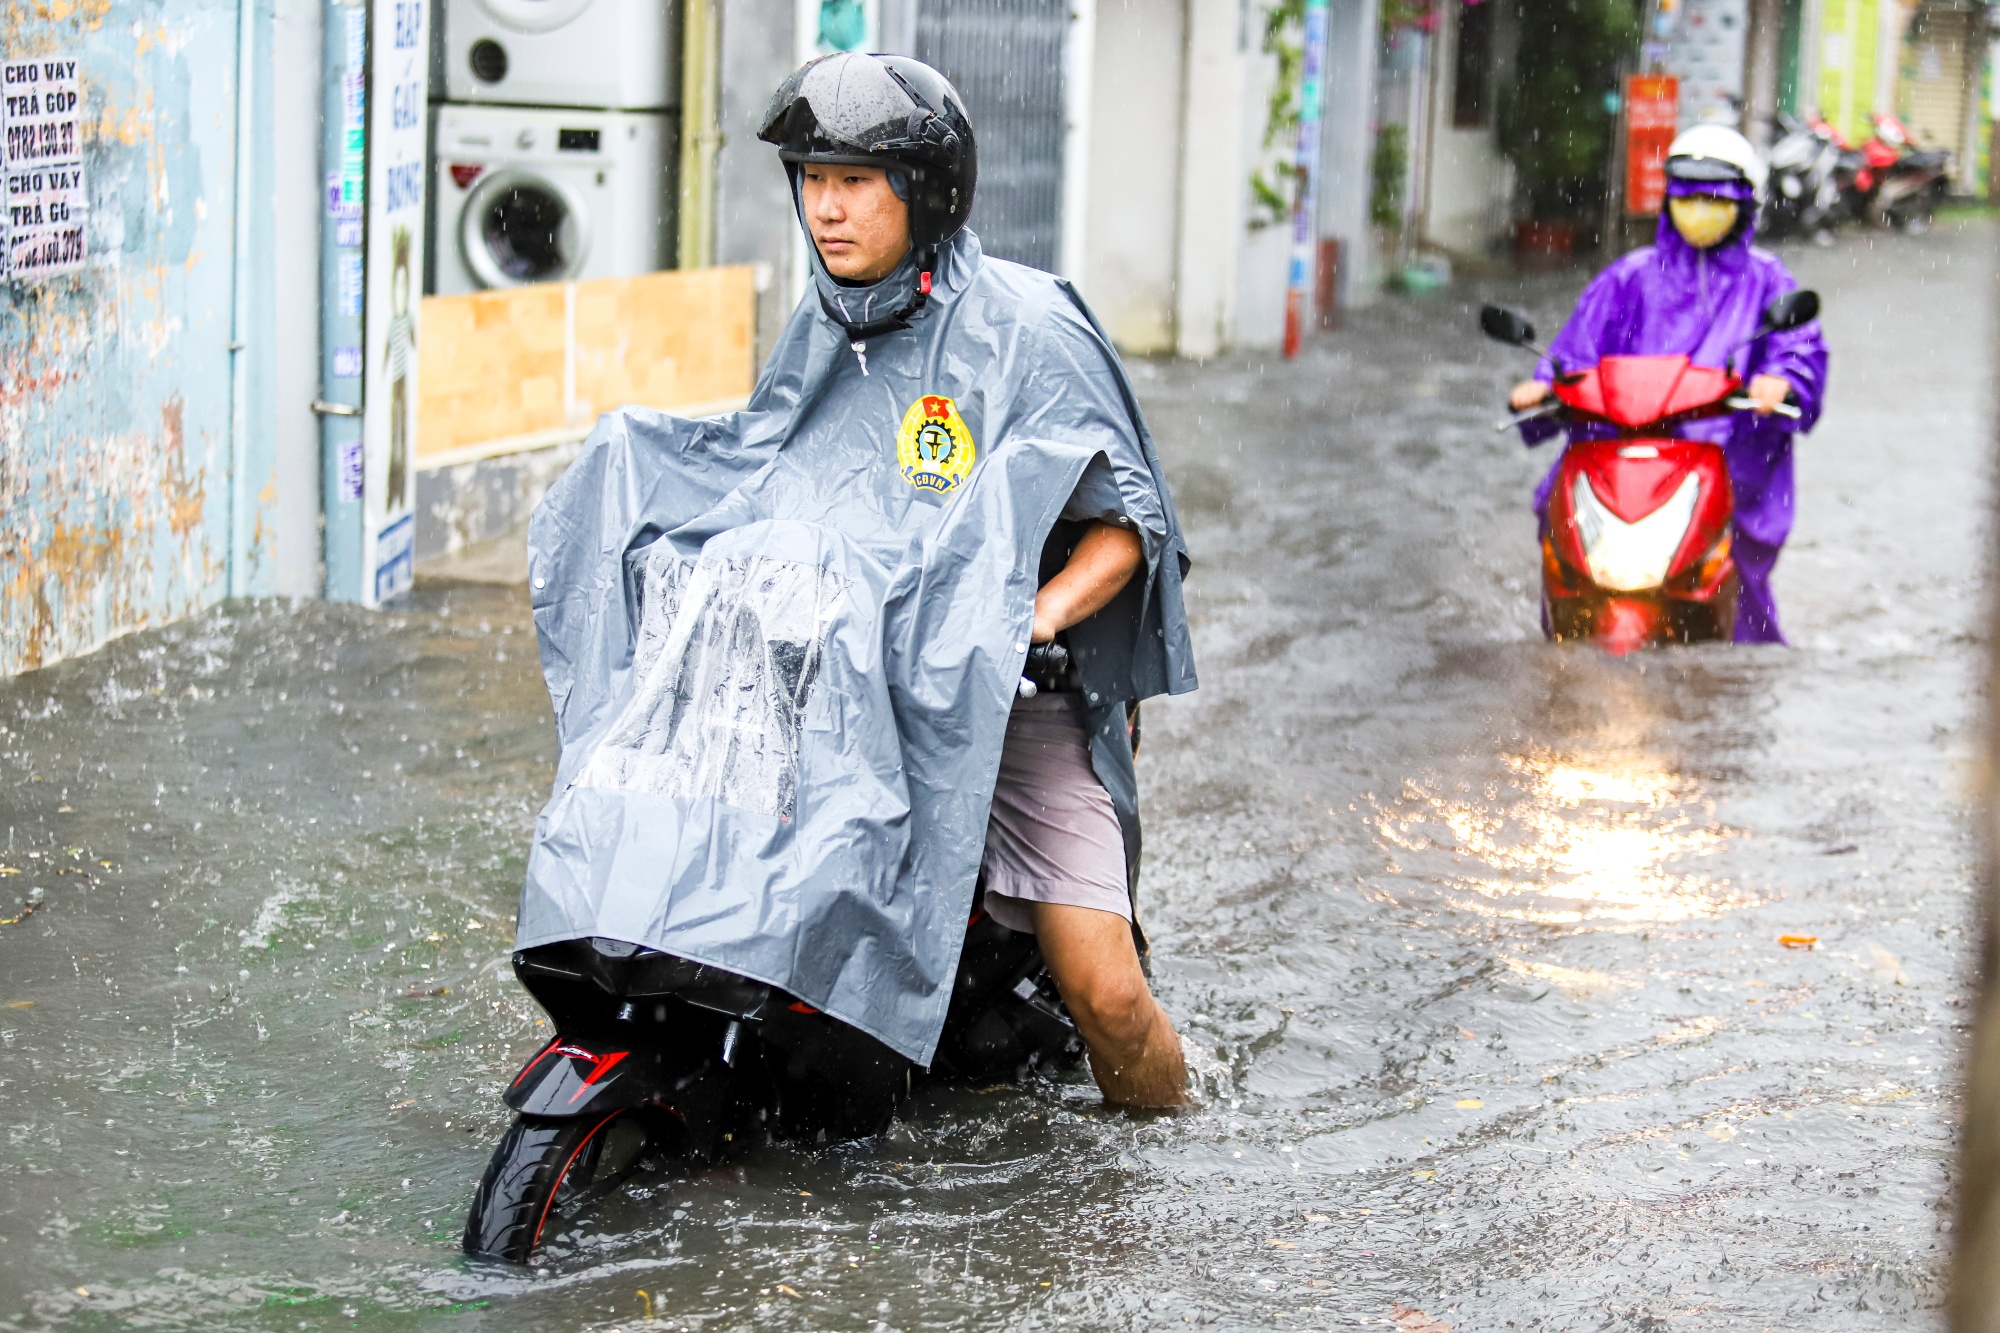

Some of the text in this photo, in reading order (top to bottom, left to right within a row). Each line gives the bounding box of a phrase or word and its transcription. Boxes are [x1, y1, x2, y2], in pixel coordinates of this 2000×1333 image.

[5, 61, 77, 84] CHO VAY
[7, 86, 77, 118] TRẢ GÓP
[7, 122, 76, 161] 0782.130.37
[9, 173, 43, 195] CHO
[49, 170, 81, 191] VAY
[10, 196, 44, 227] TRẢ
